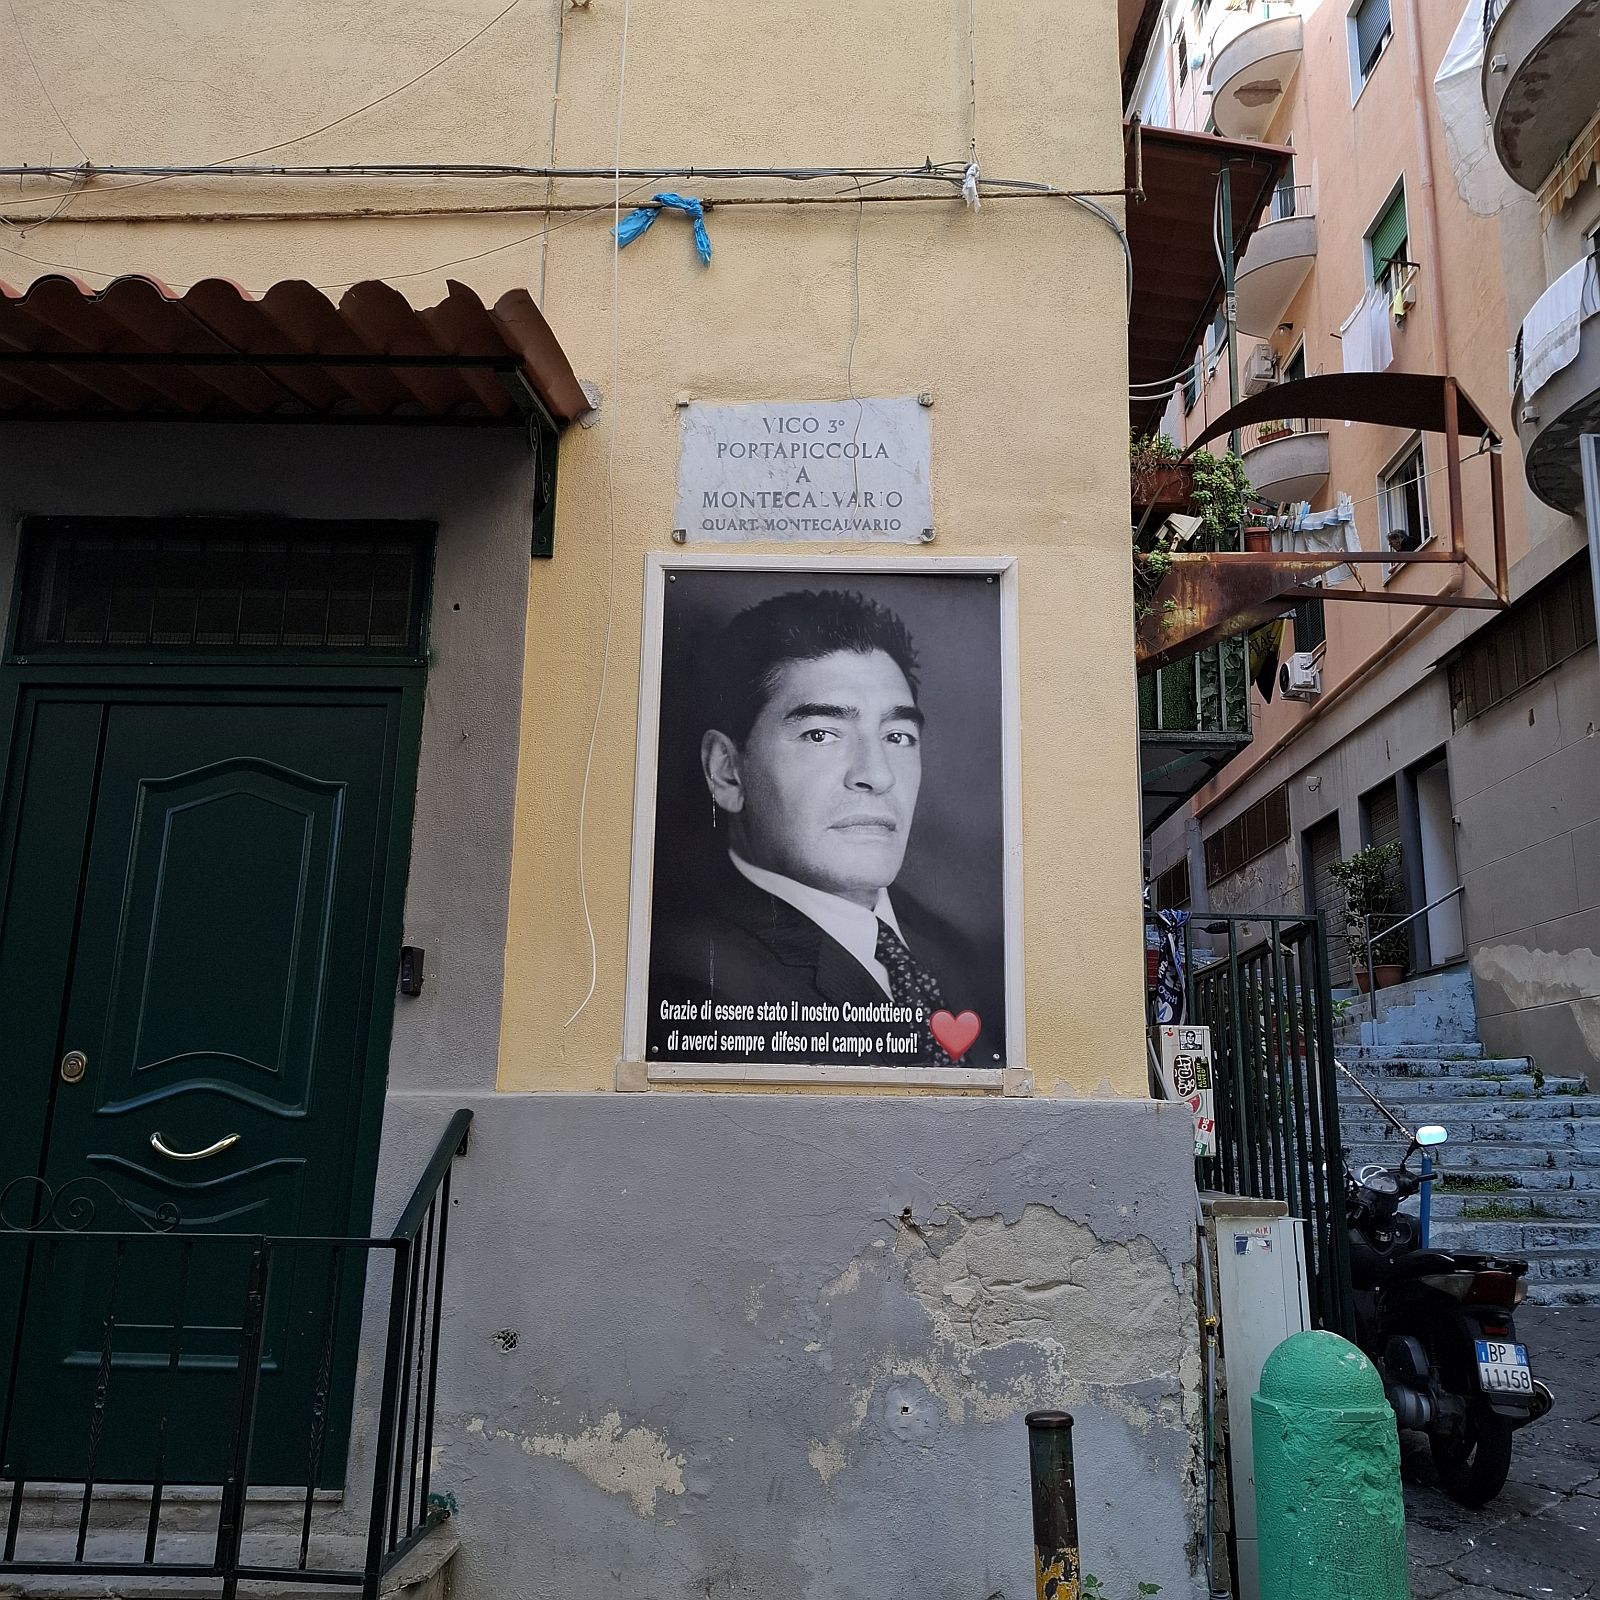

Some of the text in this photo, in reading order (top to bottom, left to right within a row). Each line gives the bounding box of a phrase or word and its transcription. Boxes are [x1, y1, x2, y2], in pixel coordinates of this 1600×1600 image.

[762, 417, 819, 434] VICO
[717, 442, 889, 459] PORTAPICCOLA
[795, 465, 811, 483] A
[702, 491, 903, 509] MONTECALVARIO
[764, 518, 902, 531] MONTECALVARIO
[660, 1000, 923, 1023] Grazie di essere stato il nostro Condottiero e
[667, 1031, 918, 1057] di averci sempre difeso nel campo e fuori!
[1489, 1344, 1506, 1362] BP
[1485, 1368, 1530, 1389] 11158
